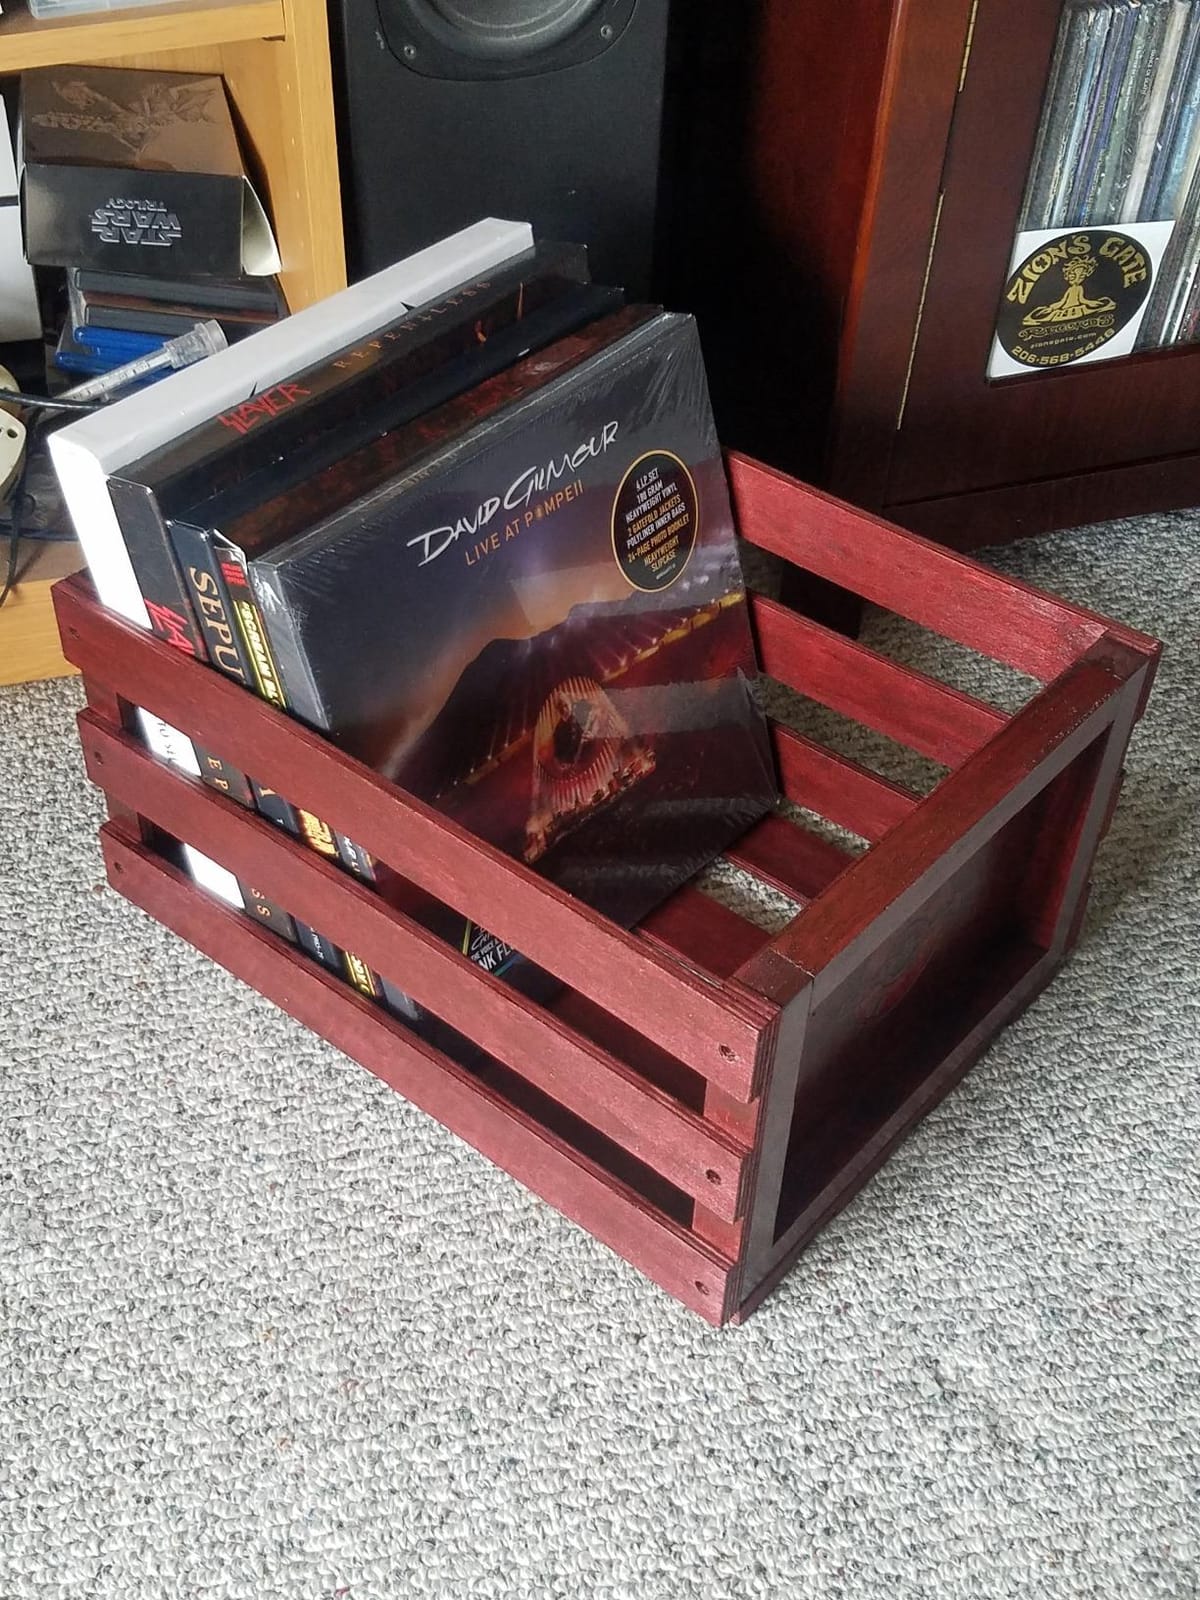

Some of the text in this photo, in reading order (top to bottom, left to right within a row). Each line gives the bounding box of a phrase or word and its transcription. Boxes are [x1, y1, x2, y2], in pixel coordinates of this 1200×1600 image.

[92, 209, 182, 230] WARS
[106, 198, 168, 213] TRILOGY
[92, 226, 182, 247] STAR
[1006, 234, 1148, 305] ZION'S GATE
[217, 381, 311, 435] SLAYER
[406, 420, 619, 567] DAVID GILMOUR
[647, 480, 664, 499] GRAM
[648, 467, 660, 483] SET
[626, 482, 678, 523] HEAVYWEIGHT VINYL
[632, 509, 659, 535] GATEFOLD
[659, 494, 682, 514] JACKETS
[465, 478, 585, 566] LIVE AT POMPEII
[627, 502, 687, 549] POLYLINER INNER BAGS
[650, 529, 667, 548] PHOTO
[667, 513, 690, 535] BOOKLET
[643, 535, 679, 567] HEAVYWEIGHT
[651, 549, 676, 572] SLIPCASE
[189, 566, 247, 685] SEPU
